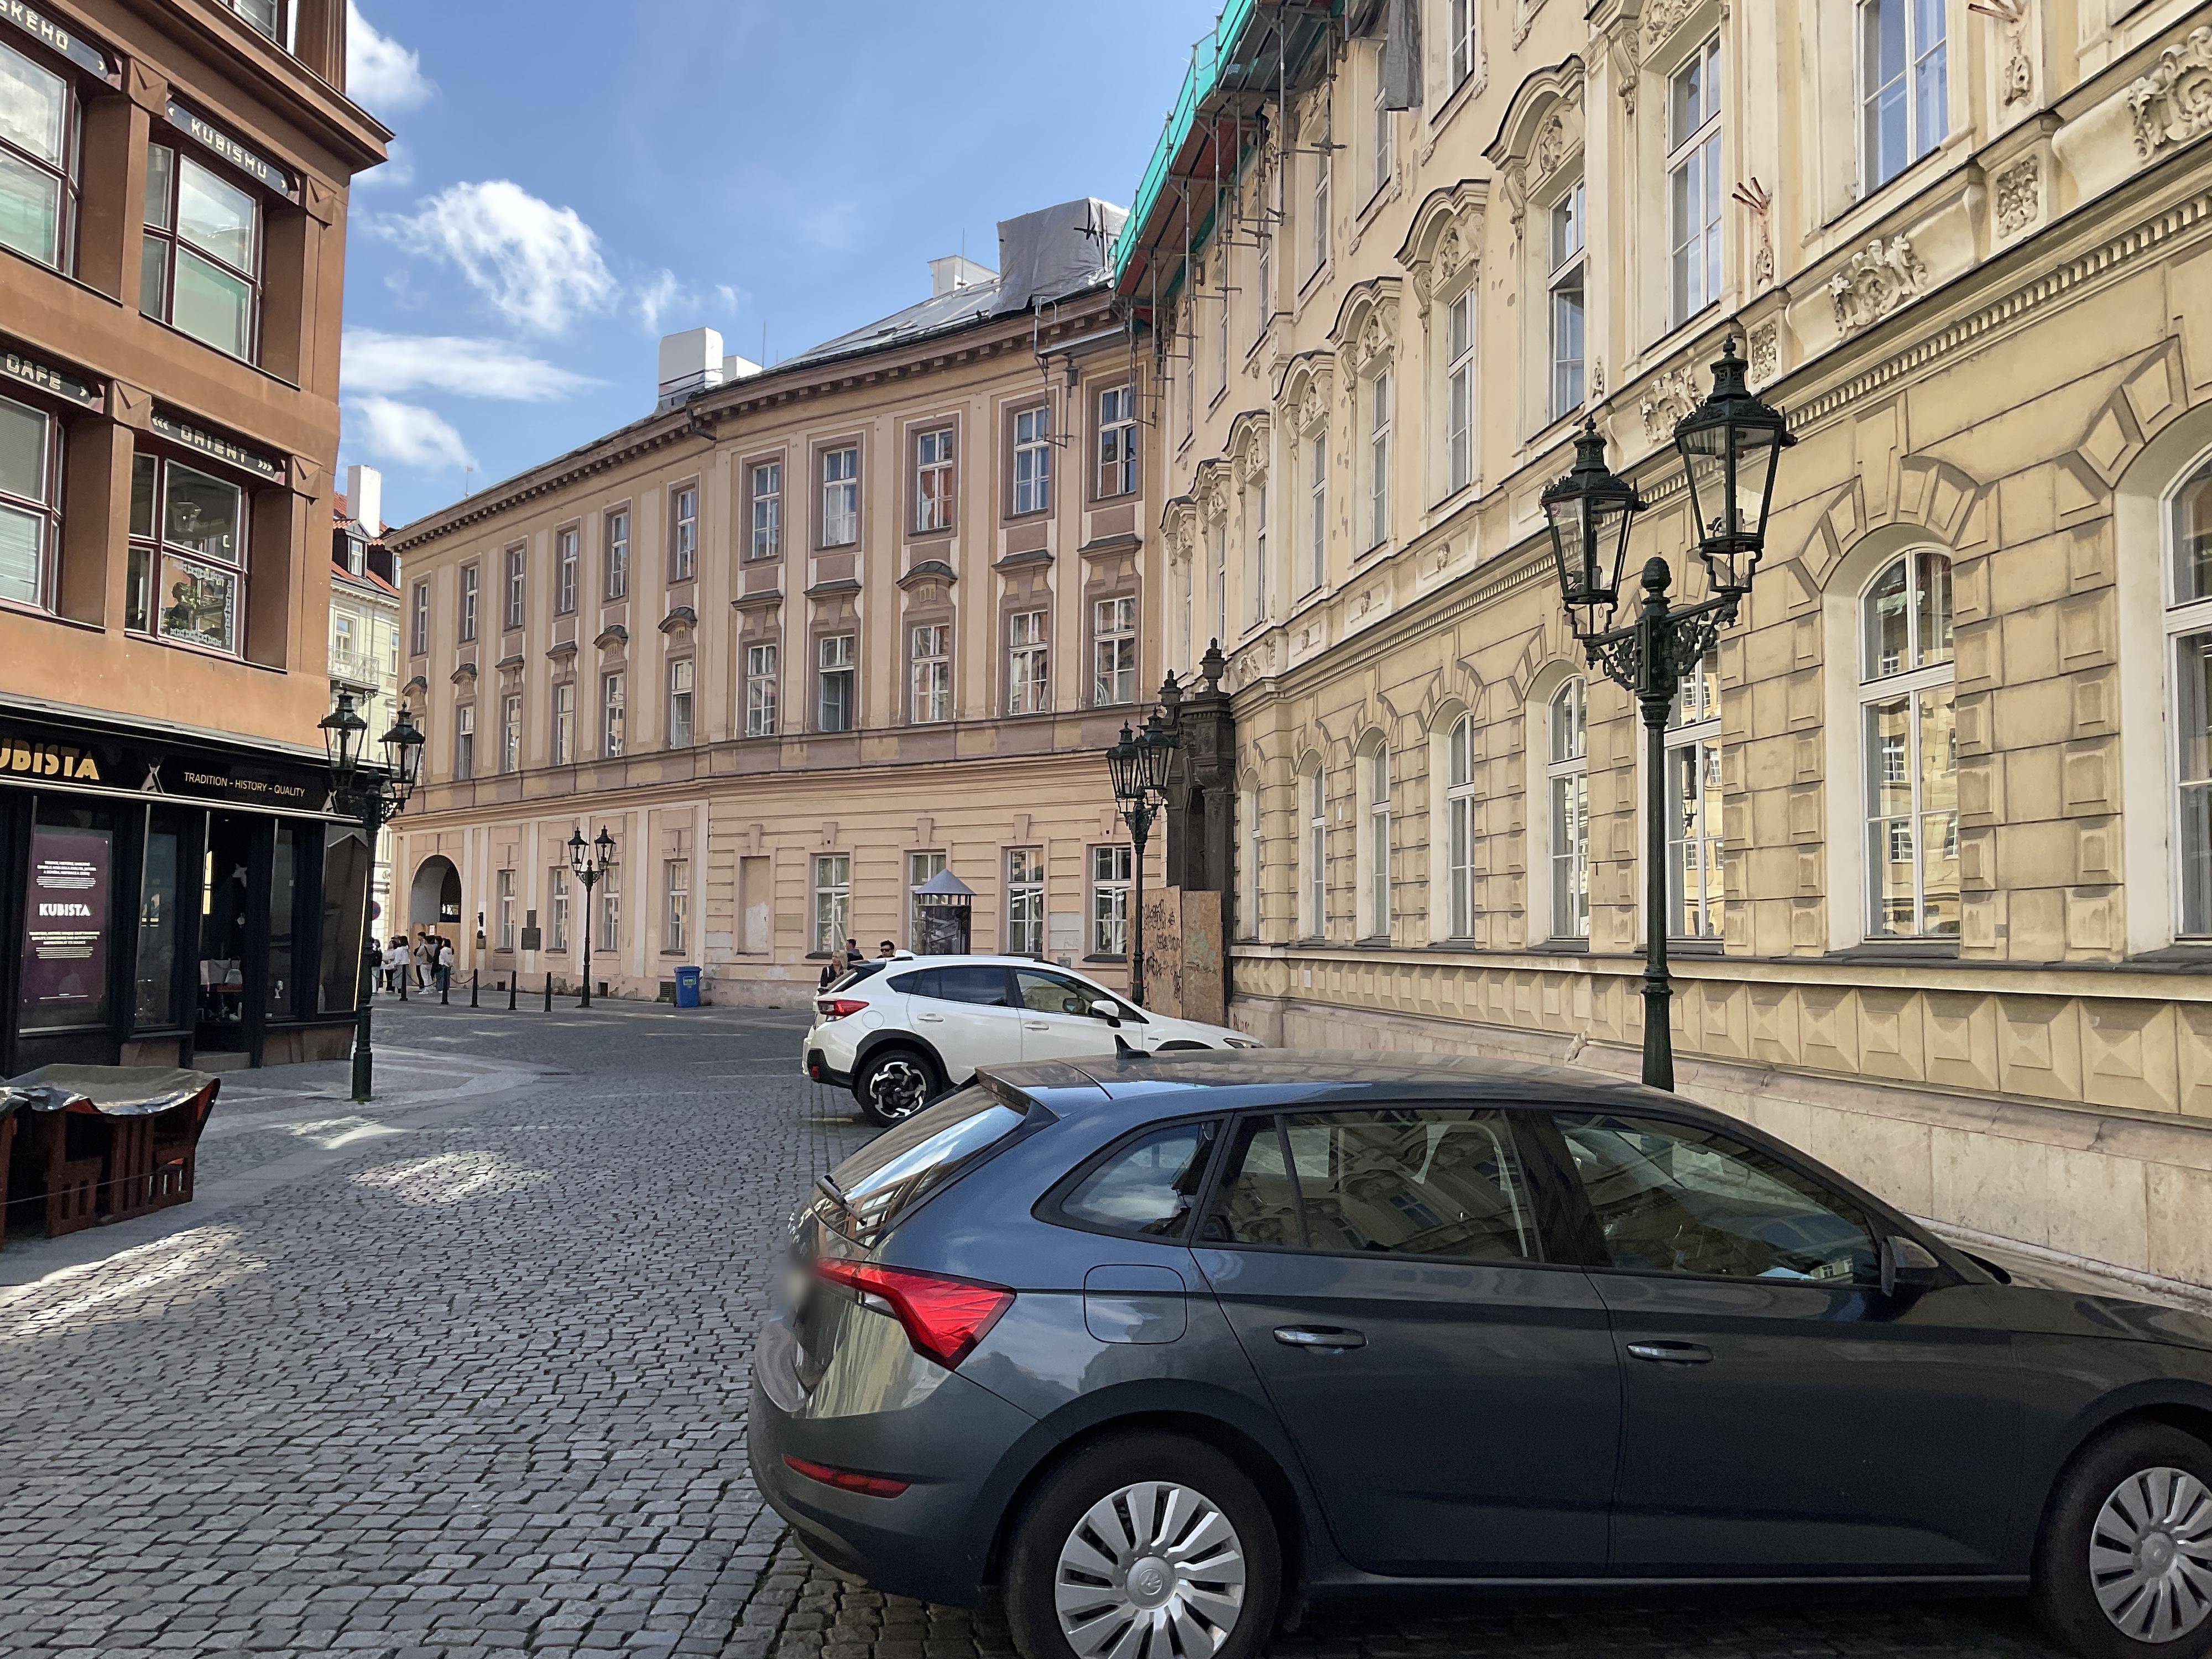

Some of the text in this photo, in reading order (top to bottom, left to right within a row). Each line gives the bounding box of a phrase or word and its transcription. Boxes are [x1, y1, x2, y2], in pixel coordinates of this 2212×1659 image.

[191, 118, 267, 179] KUBISMU
[6, 353, 61, 390] CAFE
[180, 424, 248, 463] ORIENT
[184, 772, 227, 787] TRADITION
[235, 779, 268, 792] HISTORY
[274, 785, 305, 797] QUALITY
[39, 903, 91, 916] KUBISTA
